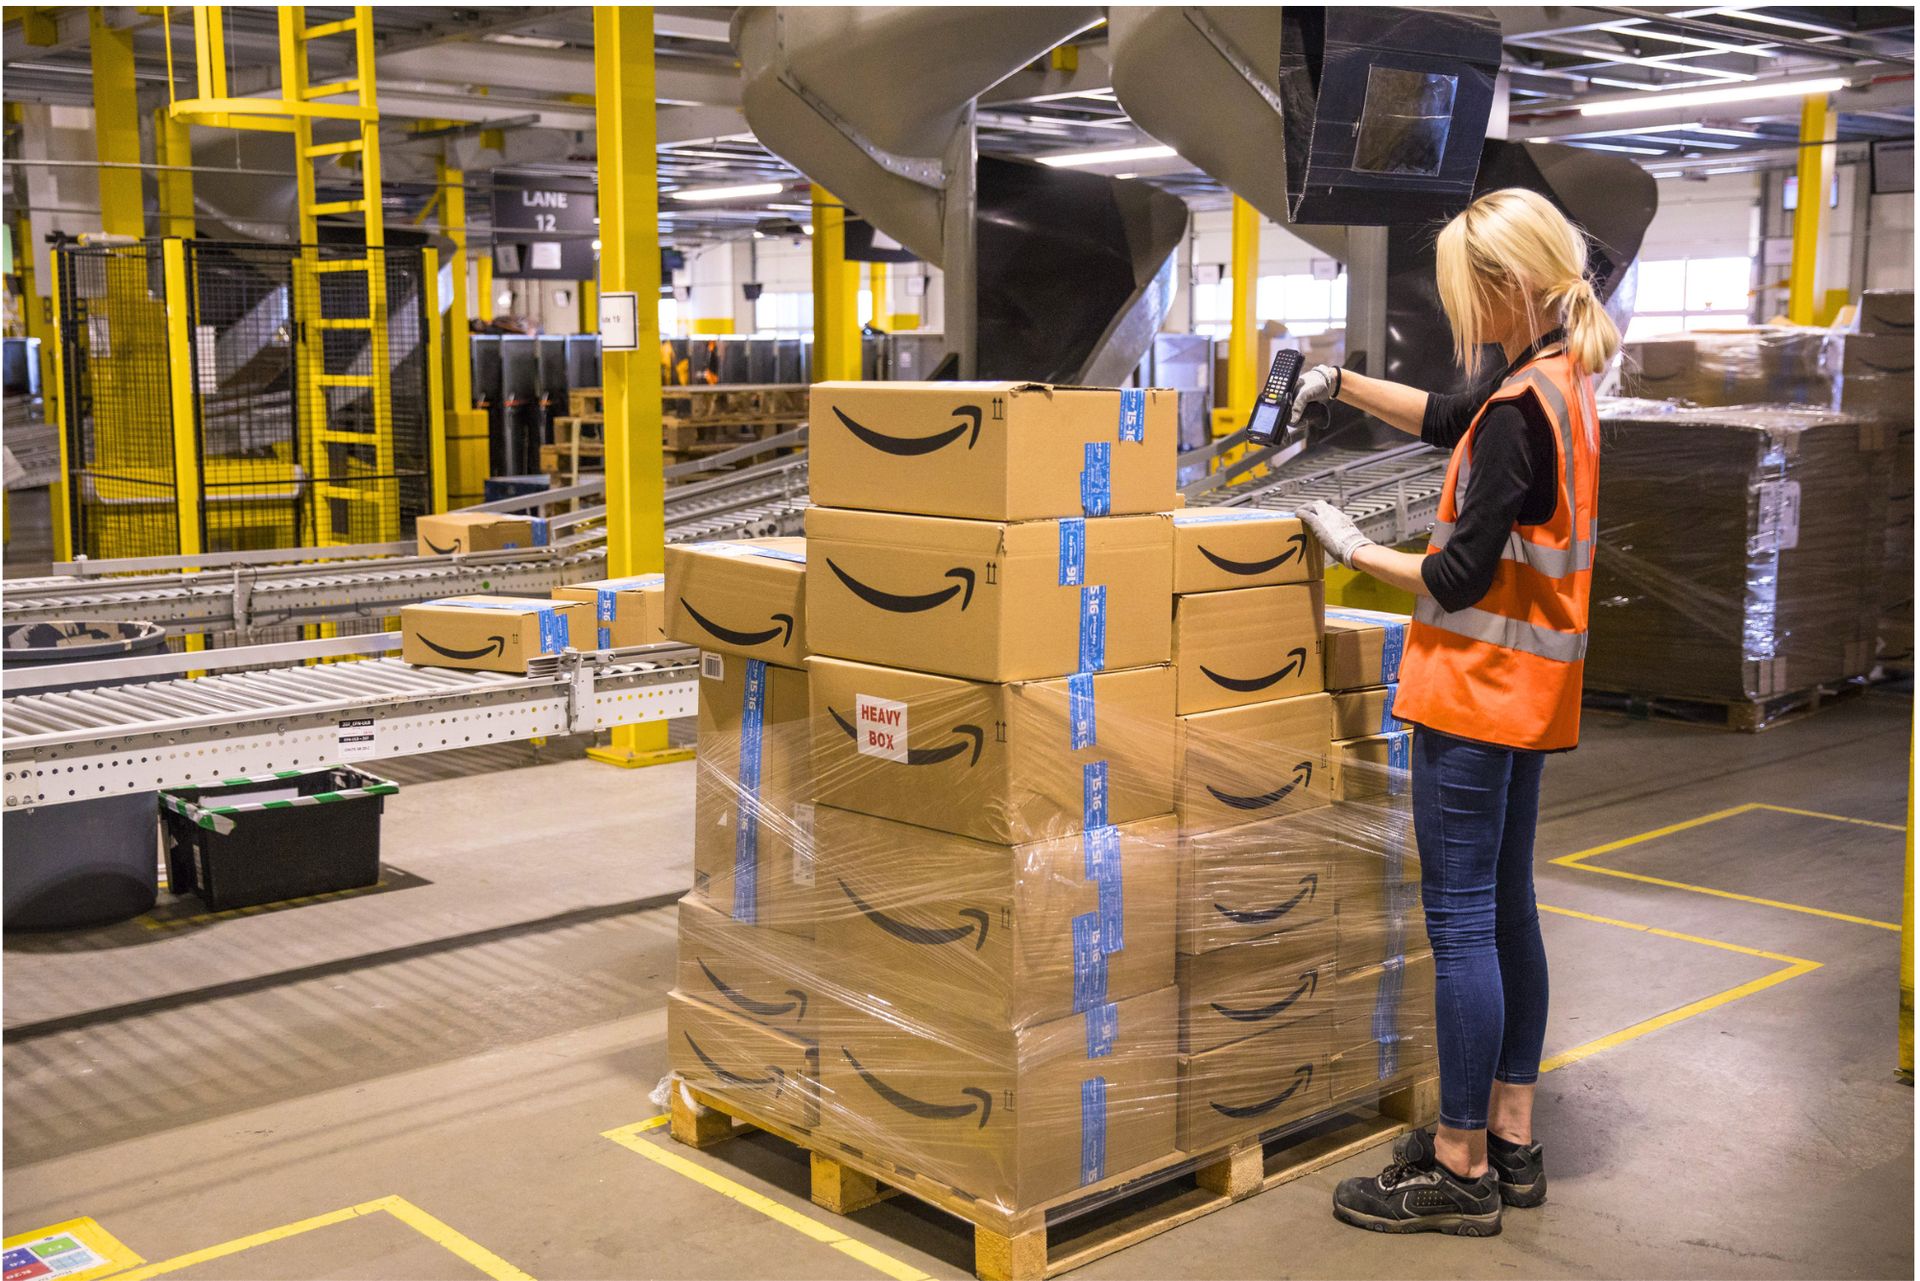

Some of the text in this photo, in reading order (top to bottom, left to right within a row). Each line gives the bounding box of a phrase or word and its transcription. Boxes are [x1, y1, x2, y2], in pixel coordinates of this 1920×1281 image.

[522, 190, 568, 208] LANE
[535, 214, 556, 232] 12
[861, 703, 901, 727] HEAVY
[868, 730, 894, 750] BOX
